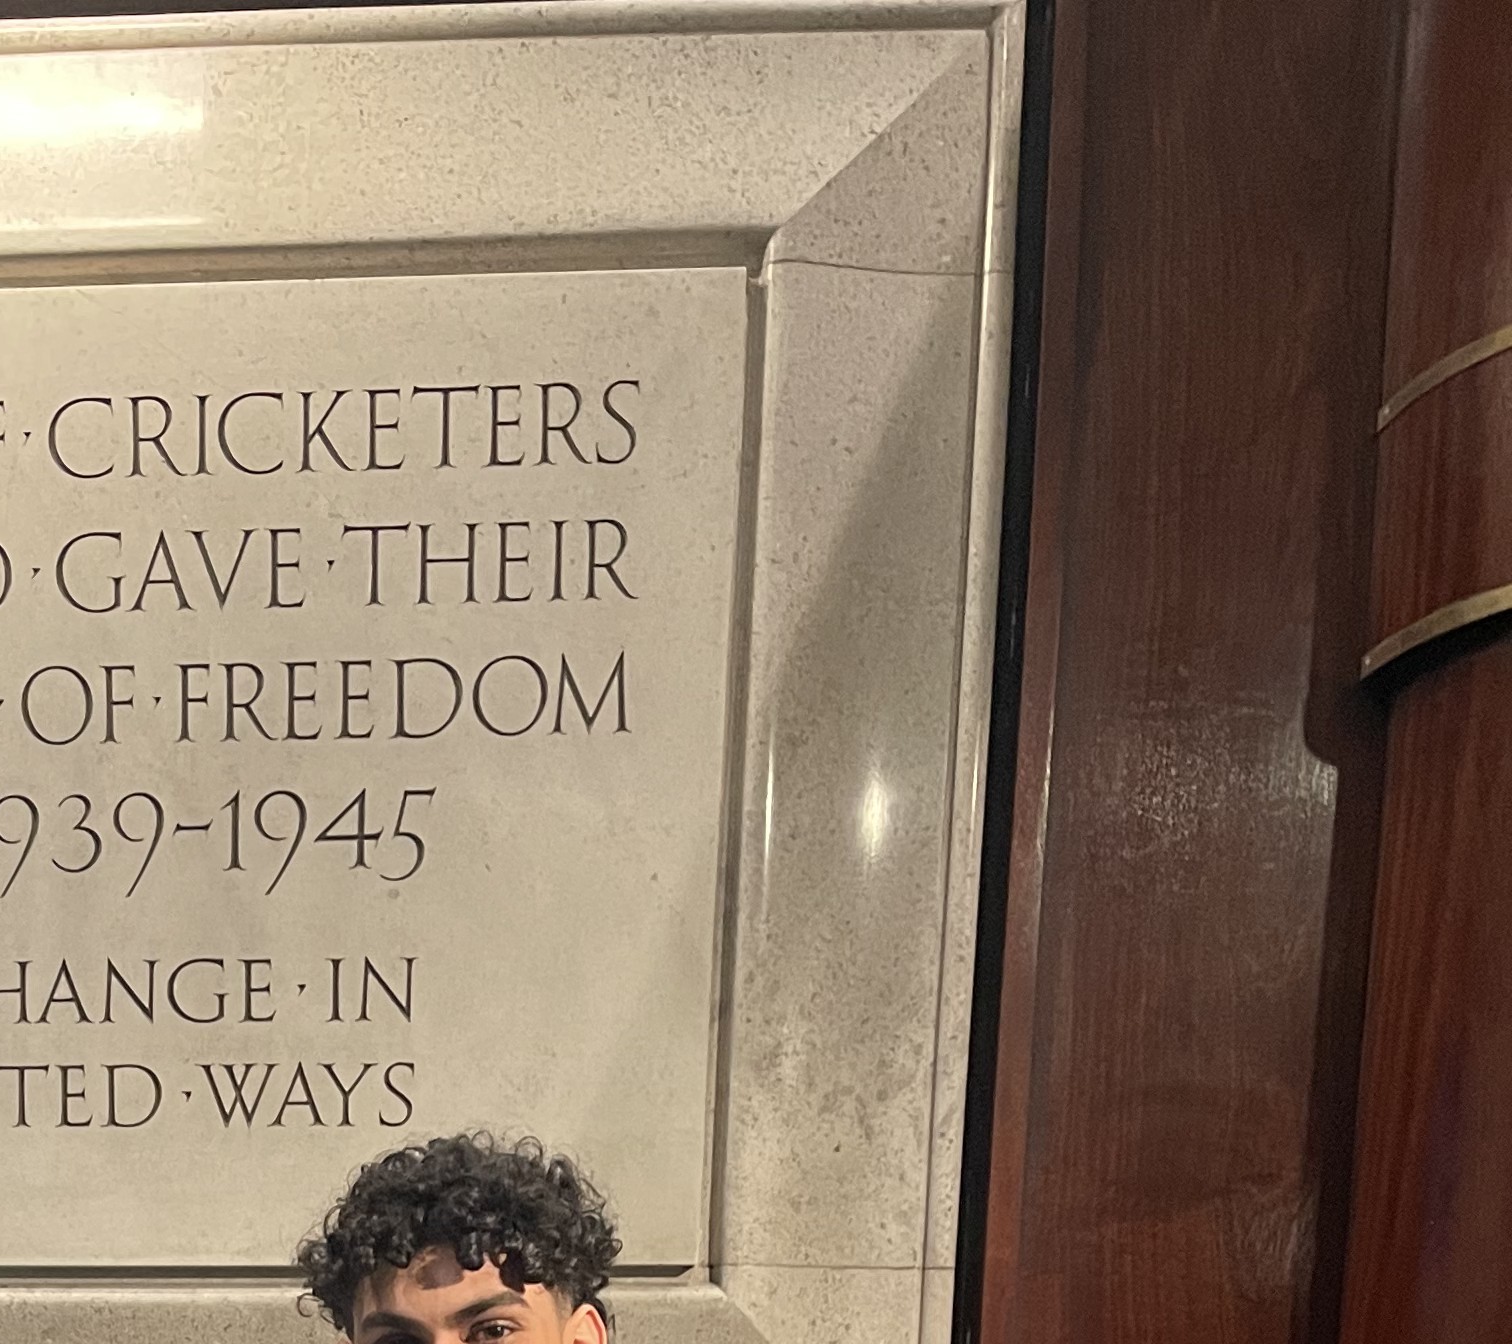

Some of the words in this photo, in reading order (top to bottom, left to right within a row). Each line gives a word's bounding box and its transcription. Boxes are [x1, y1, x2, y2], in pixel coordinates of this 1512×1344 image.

[47, 378, 643, 480] CRICKETERS
[54, 527, 305, 615] GAVE
[341, 517, 640, 608] THEIR
[20, 662, 139, 747] OF
[175, 650, 633, 744] FREEDOM
[324, 955, 420, 1025] IN
[194, 1060, 416, 1130] WAYS
